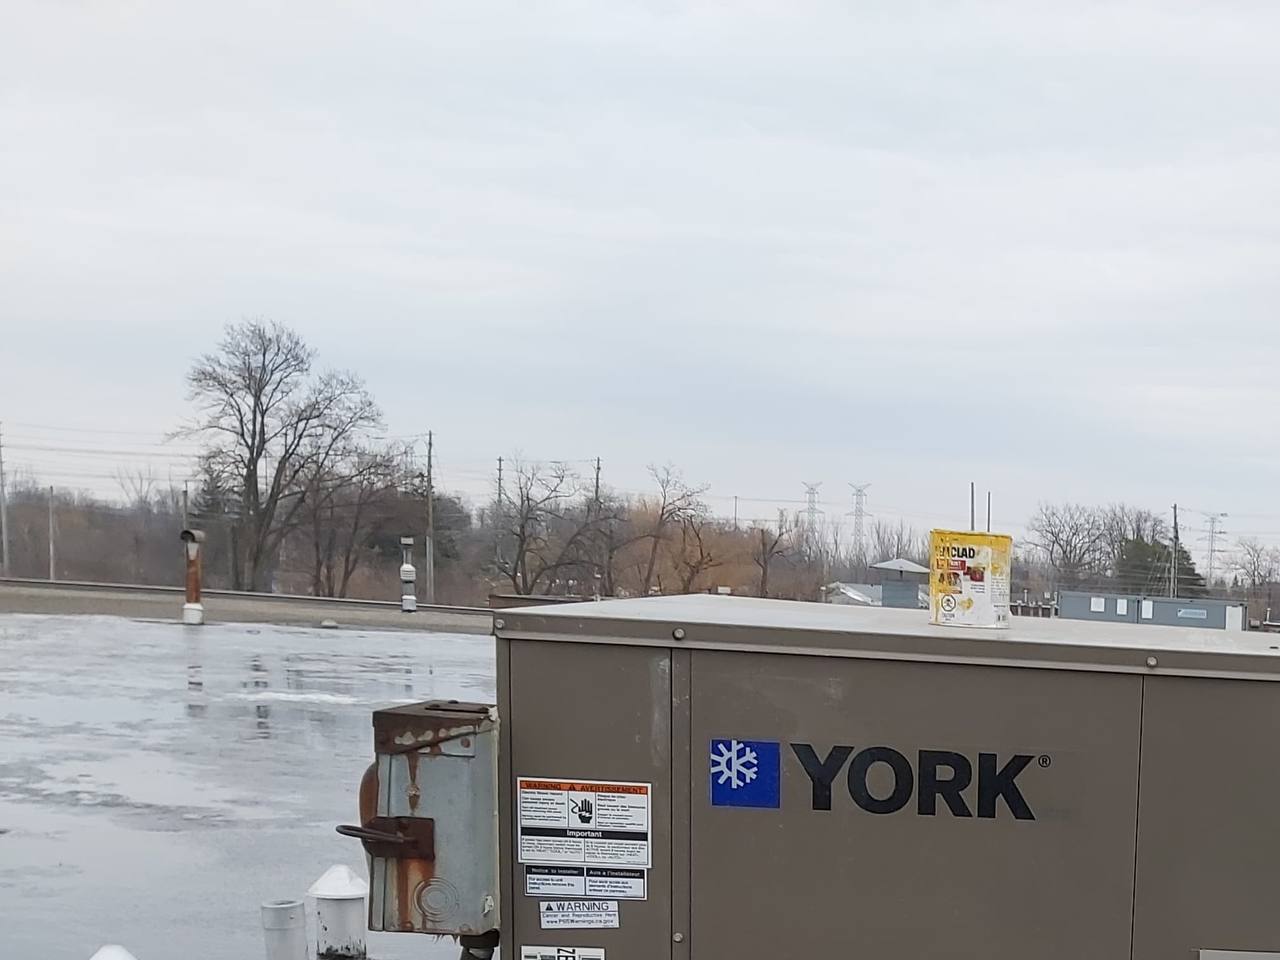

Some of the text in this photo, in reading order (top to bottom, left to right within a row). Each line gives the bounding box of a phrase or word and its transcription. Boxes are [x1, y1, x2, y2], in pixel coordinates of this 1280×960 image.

[934, 546, 976, 559] CLAD
[790, 742, 1036, 821] YORK
[525, 782, 643, 794] WARNING AVERTISSEMENT
[566, 830, 602, 838] Important
[556, 902, 609, 911] WARNING
